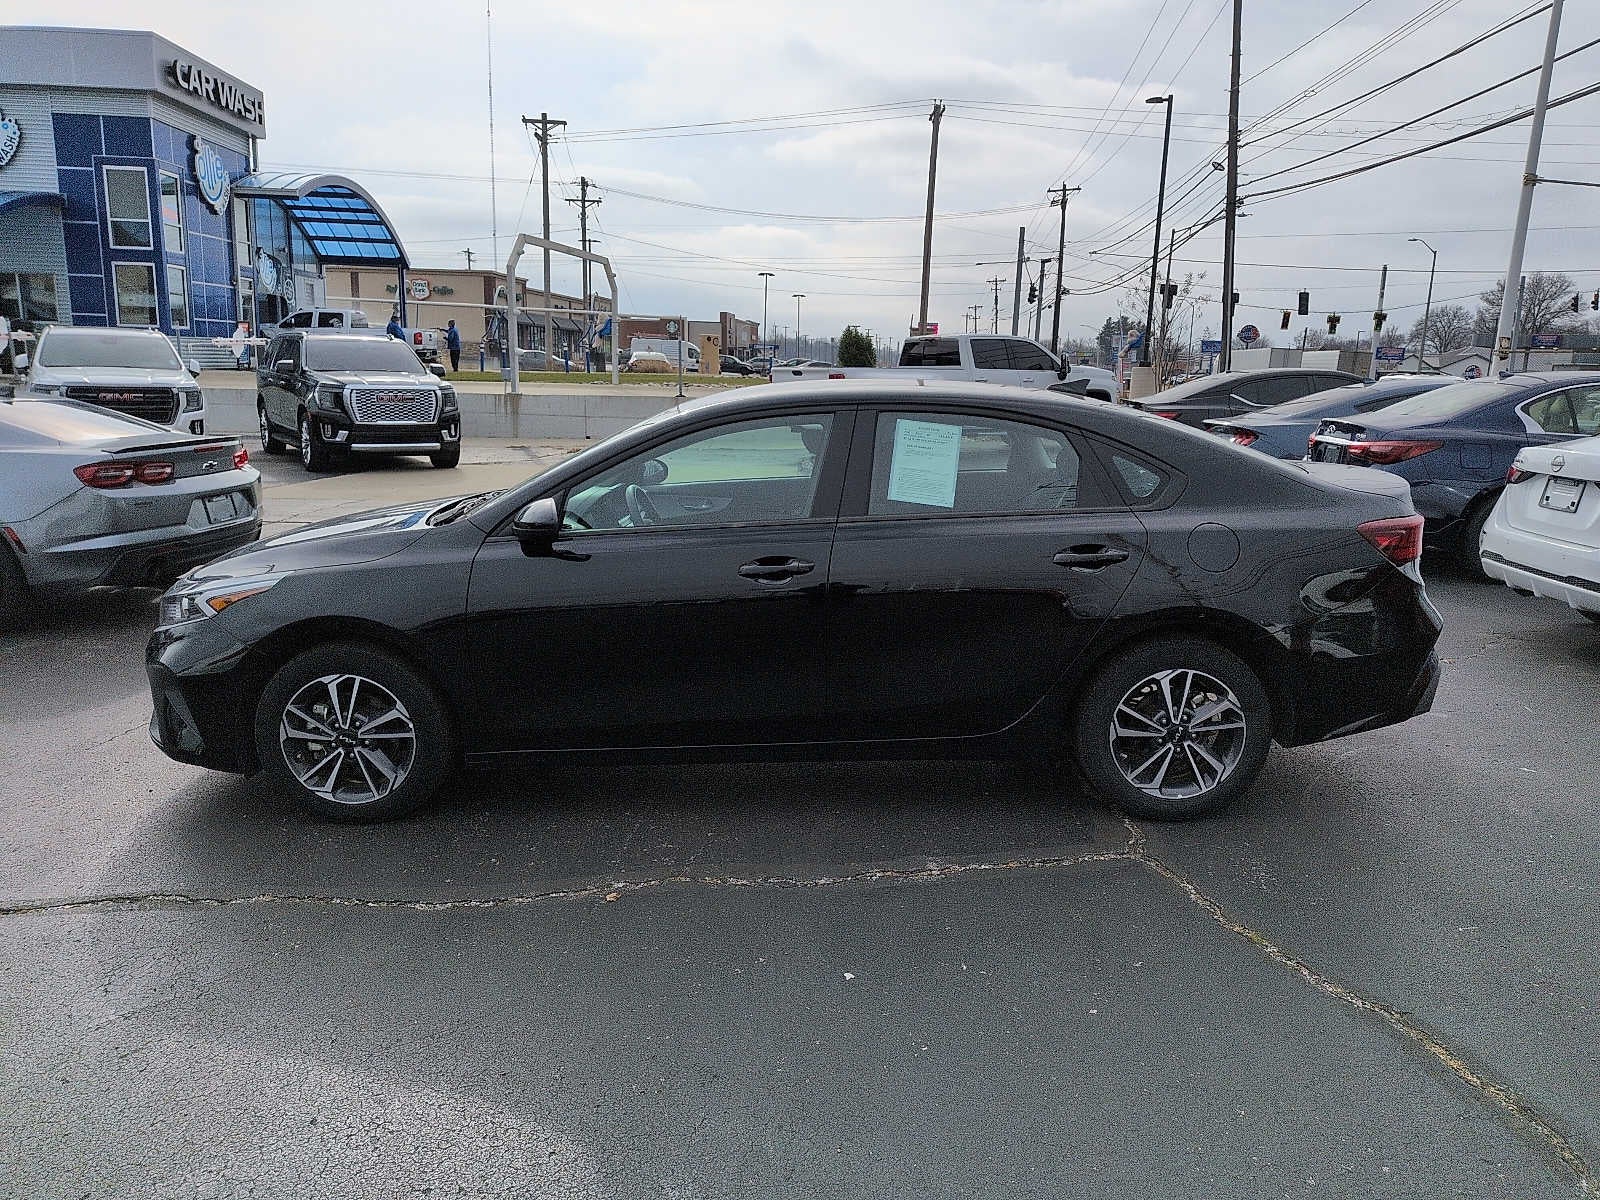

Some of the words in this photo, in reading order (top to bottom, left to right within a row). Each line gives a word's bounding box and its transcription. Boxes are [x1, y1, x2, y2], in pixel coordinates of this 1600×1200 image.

[175, 59, 215, 101] CAR
[217, 79, 264, 126] WASH
[98, 392, 144, 401] GMC
